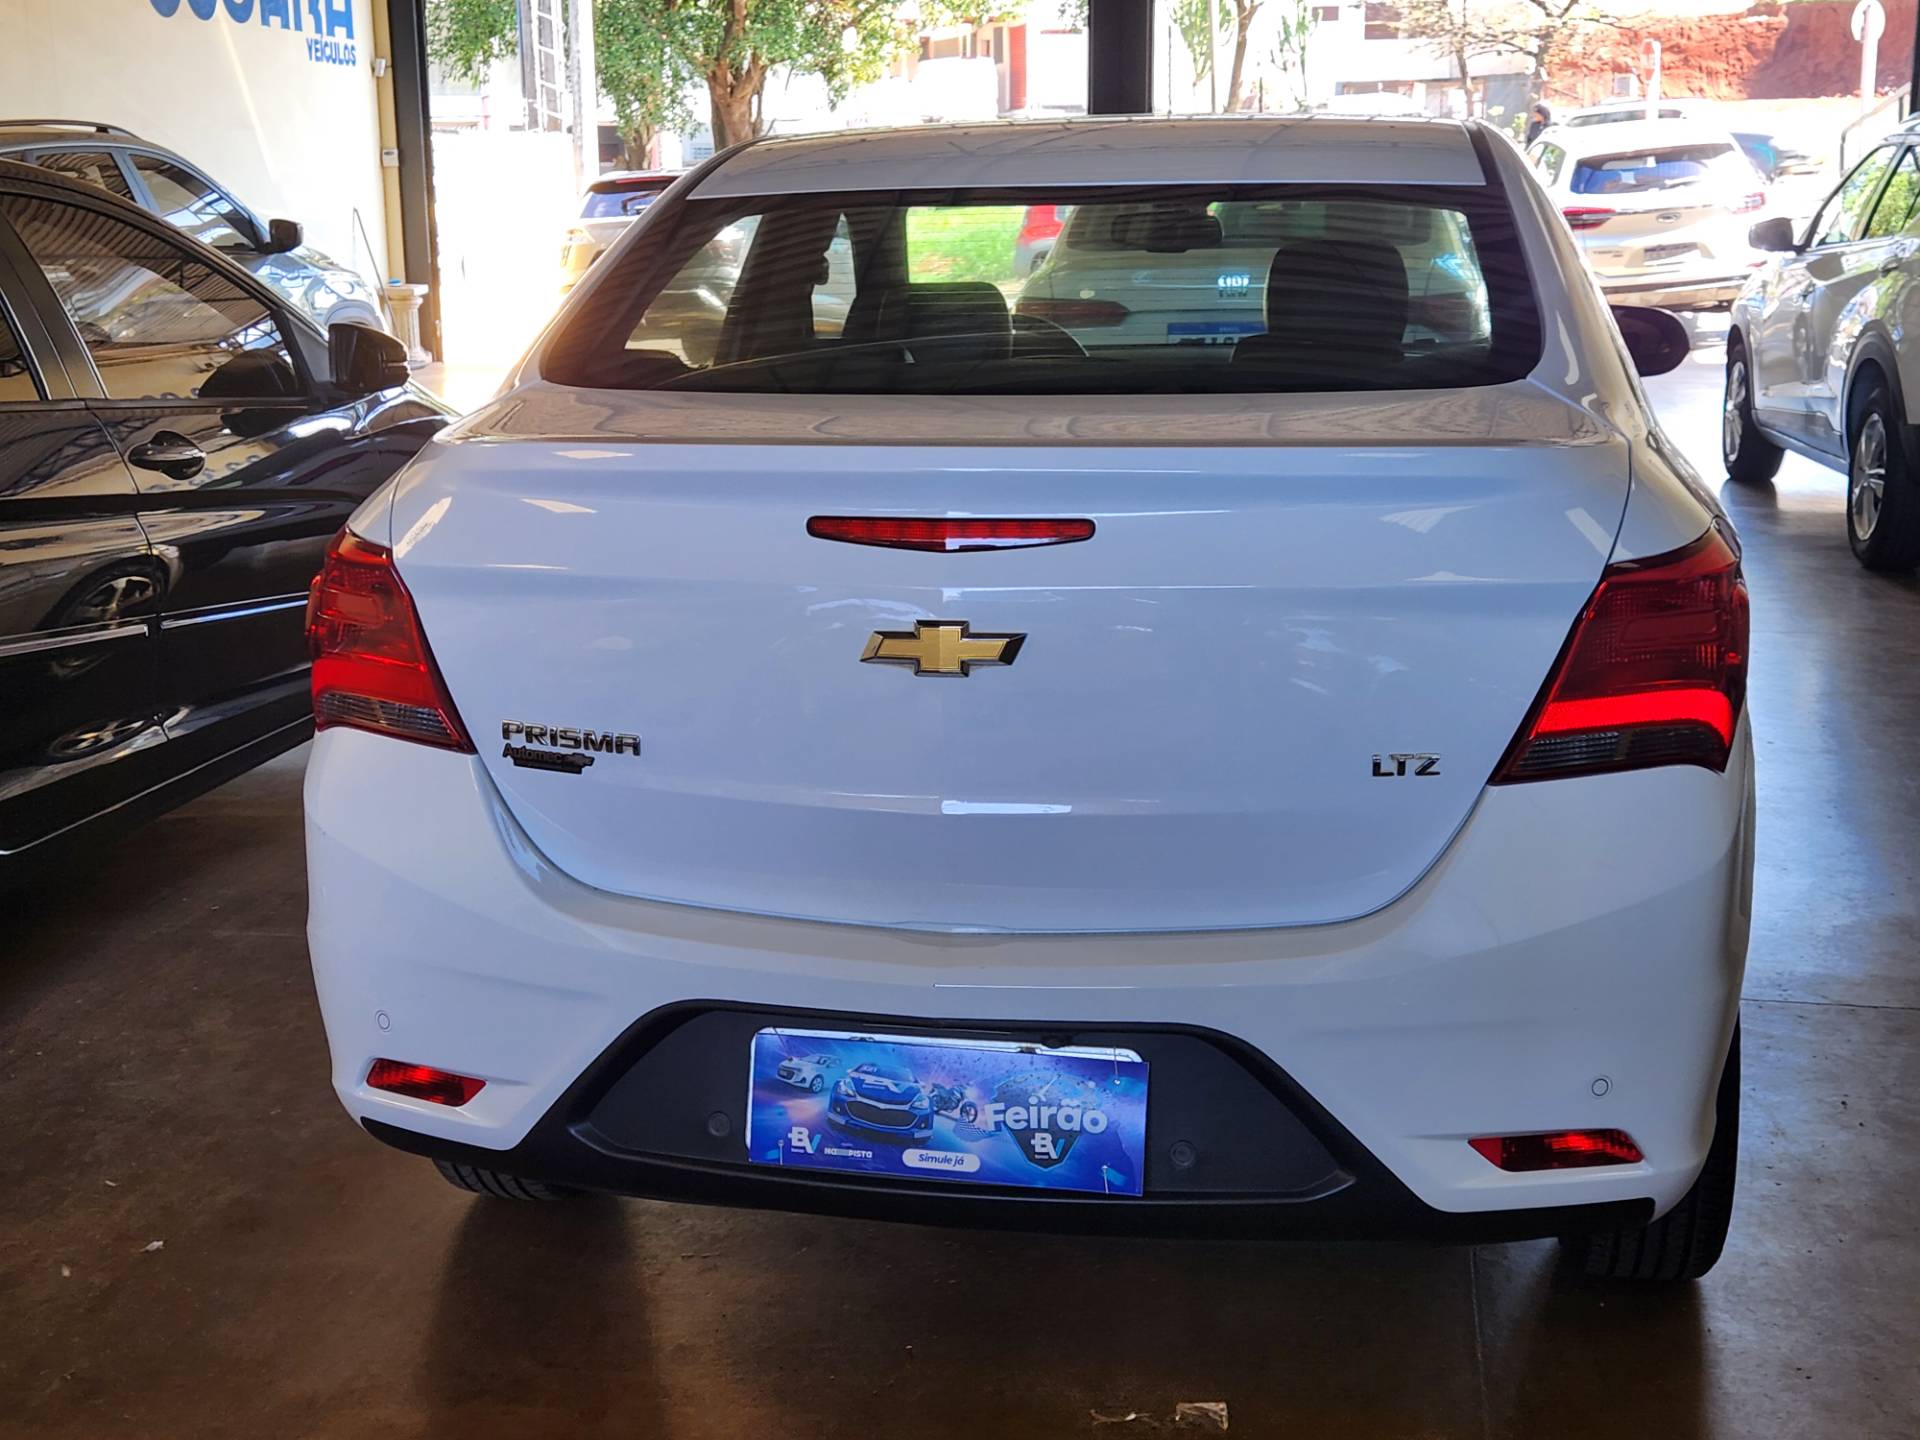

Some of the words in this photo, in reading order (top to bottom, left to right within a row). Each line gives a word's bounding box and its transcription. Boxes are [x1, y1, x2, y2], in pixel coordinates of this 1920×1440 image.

[502, 719, 641, 756] PRISMA
[1372, 752, 1441, 776] LTZ
[984, 1095, 1107, 1134] Feirão
[918, 1153, 952, 1165] Simule
[953, 1154, 965, 1167] já
